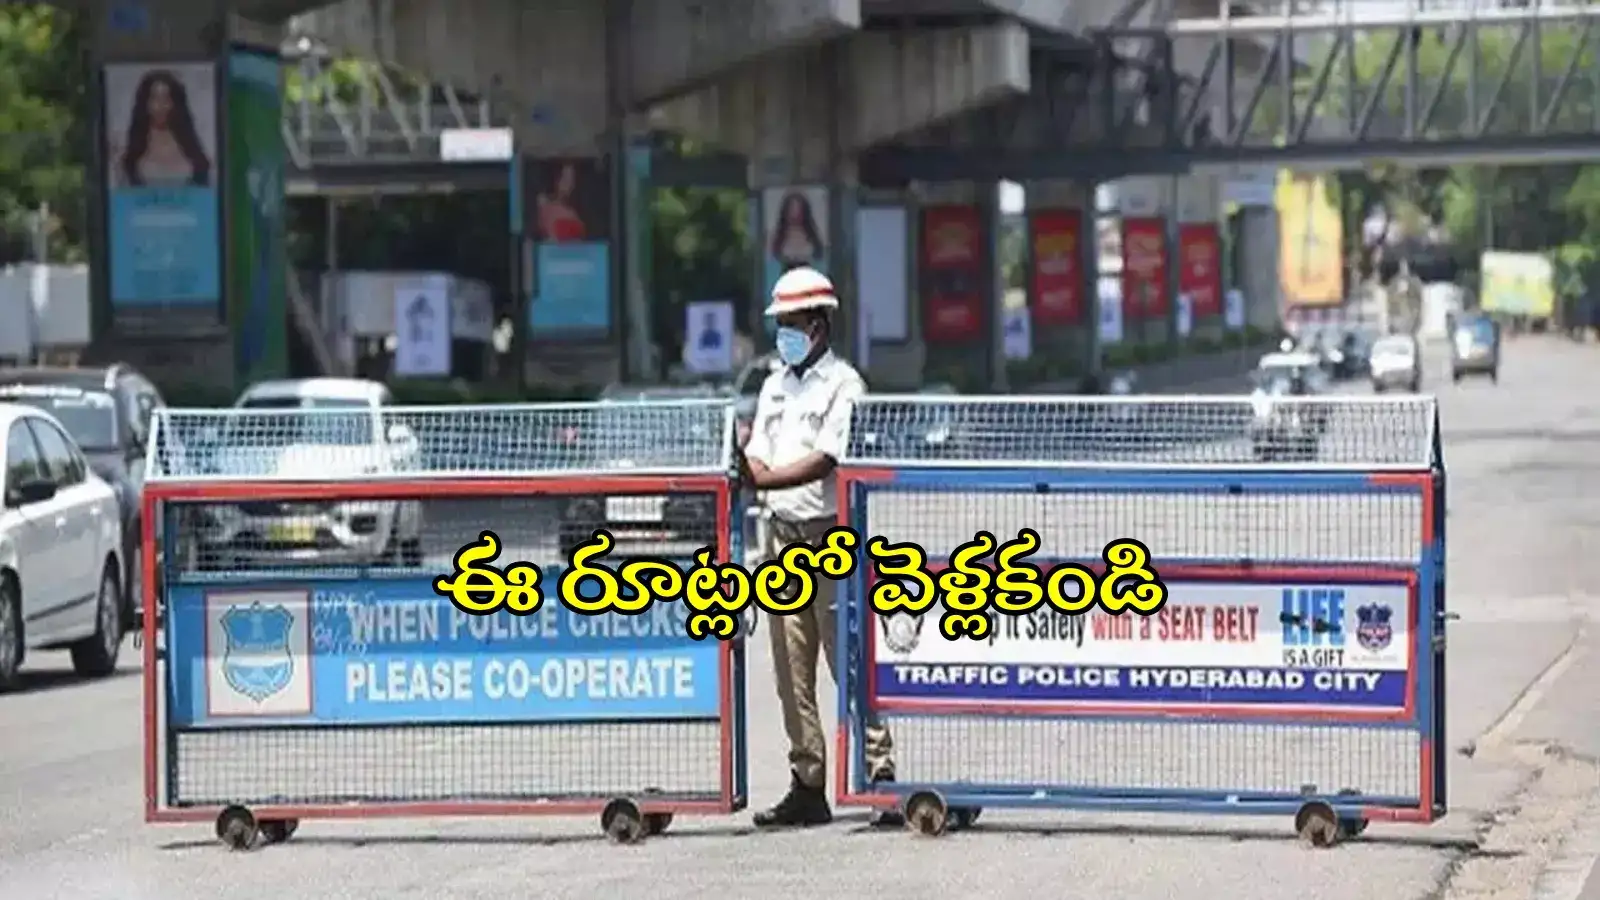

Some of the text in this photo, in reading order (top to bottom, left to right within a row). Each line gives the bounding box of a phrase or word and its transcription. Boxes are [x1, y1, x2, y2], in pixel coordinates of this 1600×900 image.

[347, 600, 439, 642] WHEN
[450, 600, 558, 640] POLICE
[568, 598, 690, 637] CHECKS
[1026, 610, 1086, 648] Safely
[1139, 613, 1151, 642] a
[1157, 605, 1207, 642] SEAT
[1212, 605, 1260, 642] BELT
[1282, 589, 1345, 645] LIFE
[893, 665, 1382, 693] TRAFFIC POLICE HYDERABAD CITY
[1299, 649, 1310, 667] A
[1312, 648, 1345, 667] GIFT
[346, 656, 695, 704] PLEASE CO-OPERATE
